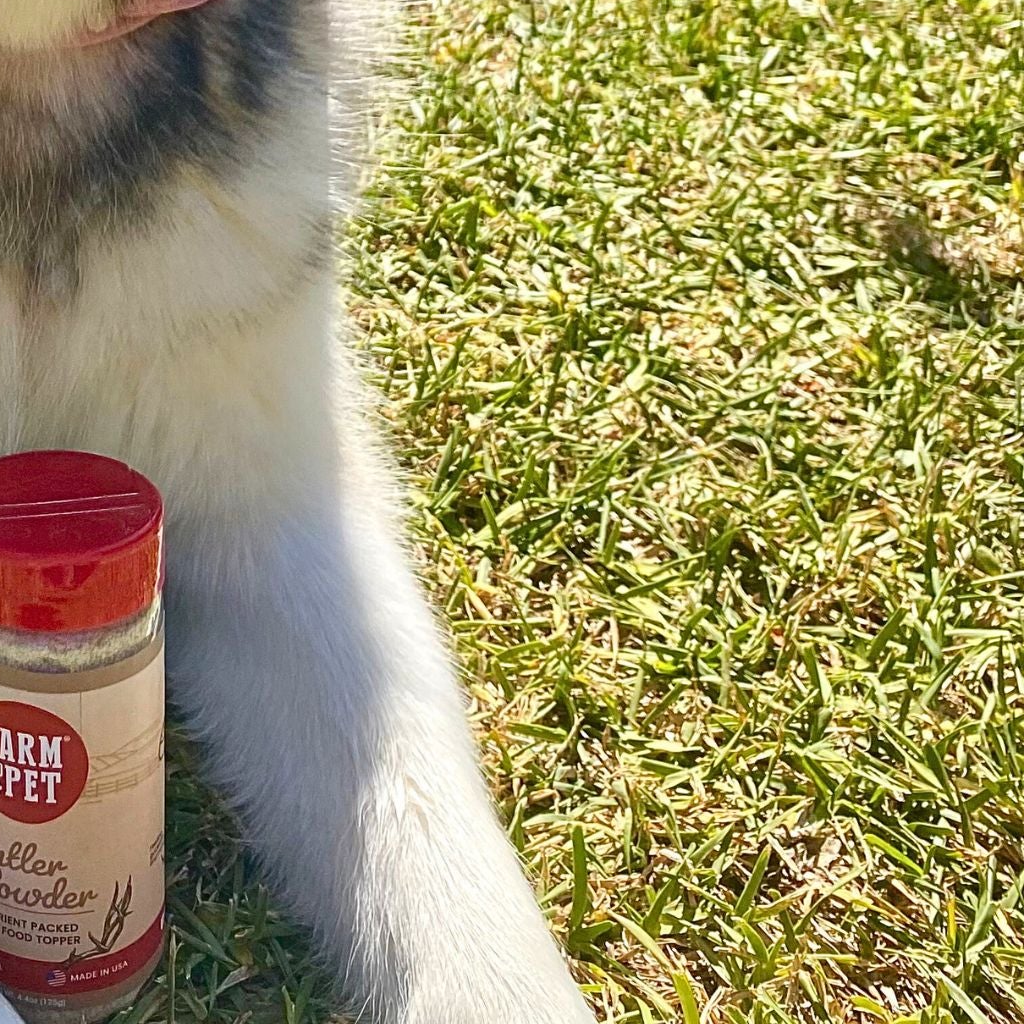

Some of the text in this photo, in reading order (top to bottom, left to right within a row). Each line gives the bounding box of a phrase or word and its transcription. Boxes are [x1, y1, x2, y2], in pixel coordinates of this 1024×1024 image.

[4, 765, 61, 804] PET
[1, 926, 33, 943] FOOD
[36, 935, 81, 946] TOPPER
[31, 921, 79, 933] PACKED
[70, 960, 129, 982] MADE IN USA
